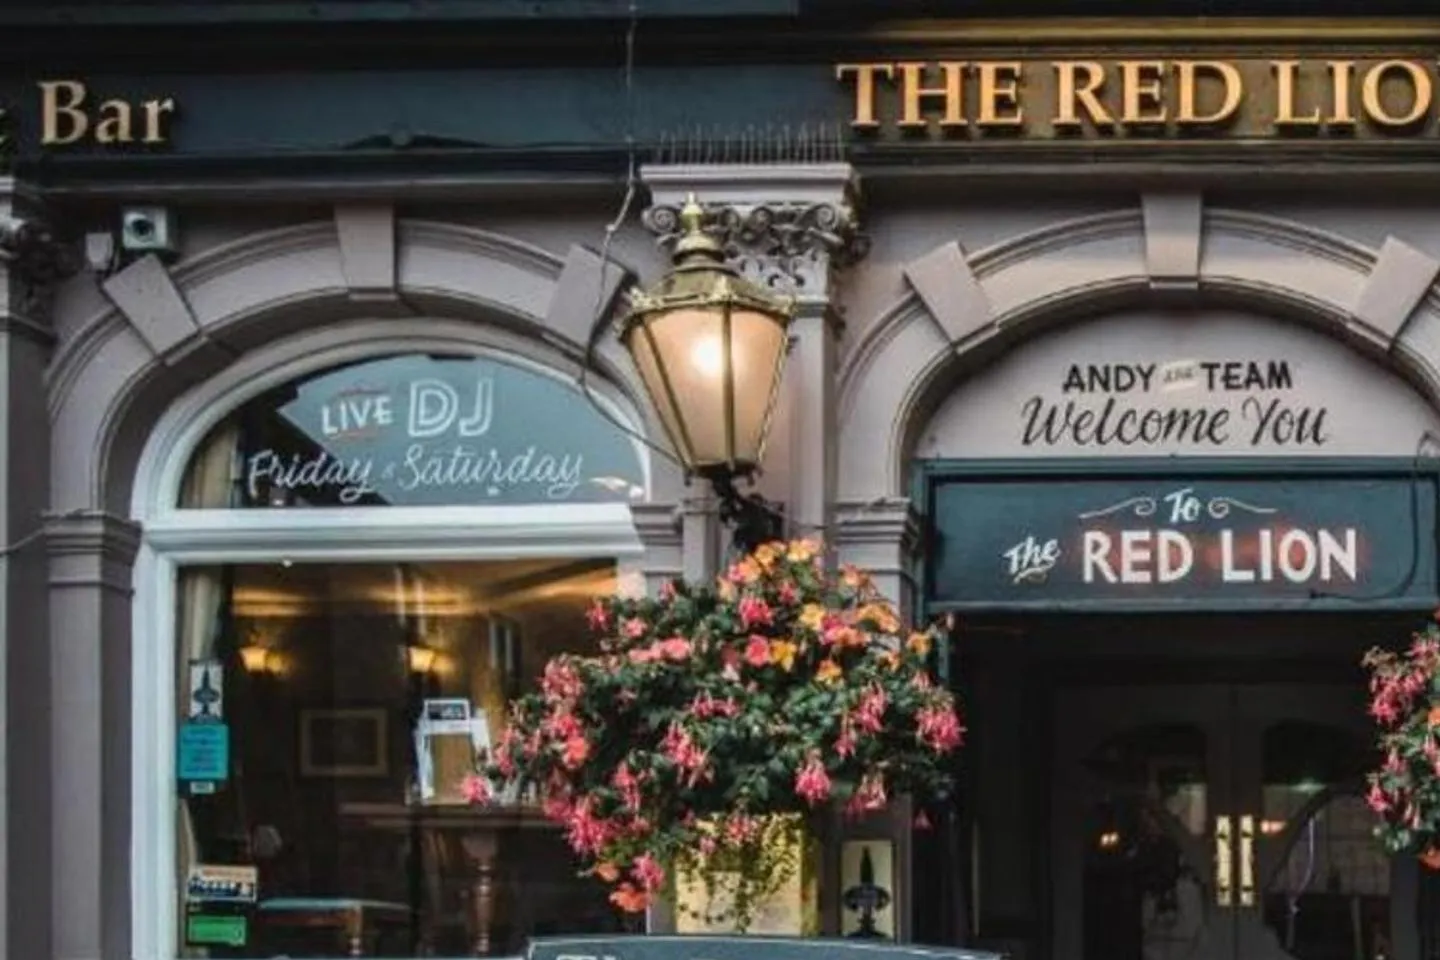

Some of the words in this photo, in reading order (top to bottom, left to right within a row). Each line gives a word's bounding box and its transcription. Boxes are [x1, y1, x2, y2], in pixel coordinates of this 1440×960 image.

[37, 79, 175, 145] Bar
[837, 60, 1023, 126] THE
[1053, 60, 1242, 126] RED
[1062, 363, 1157, 392] ANDY
[1200, 361, 1293, 391] TEAM
[321, 395, 395, 435] LIVE
[407, 377, 495, 437] DJ
[1020, 395, 1231, 446] Welcome
[1241, 395, 1329, 446] You
[249, 450, 375, 502] Friday
[399, 443, 584, 498] Saturday
[1164, 487, 1200, 523] To
[1003, 535, 1062, 577] The
[1082, 529, 1194, 583] RED
[1221, 528, 1357, 583] LION
